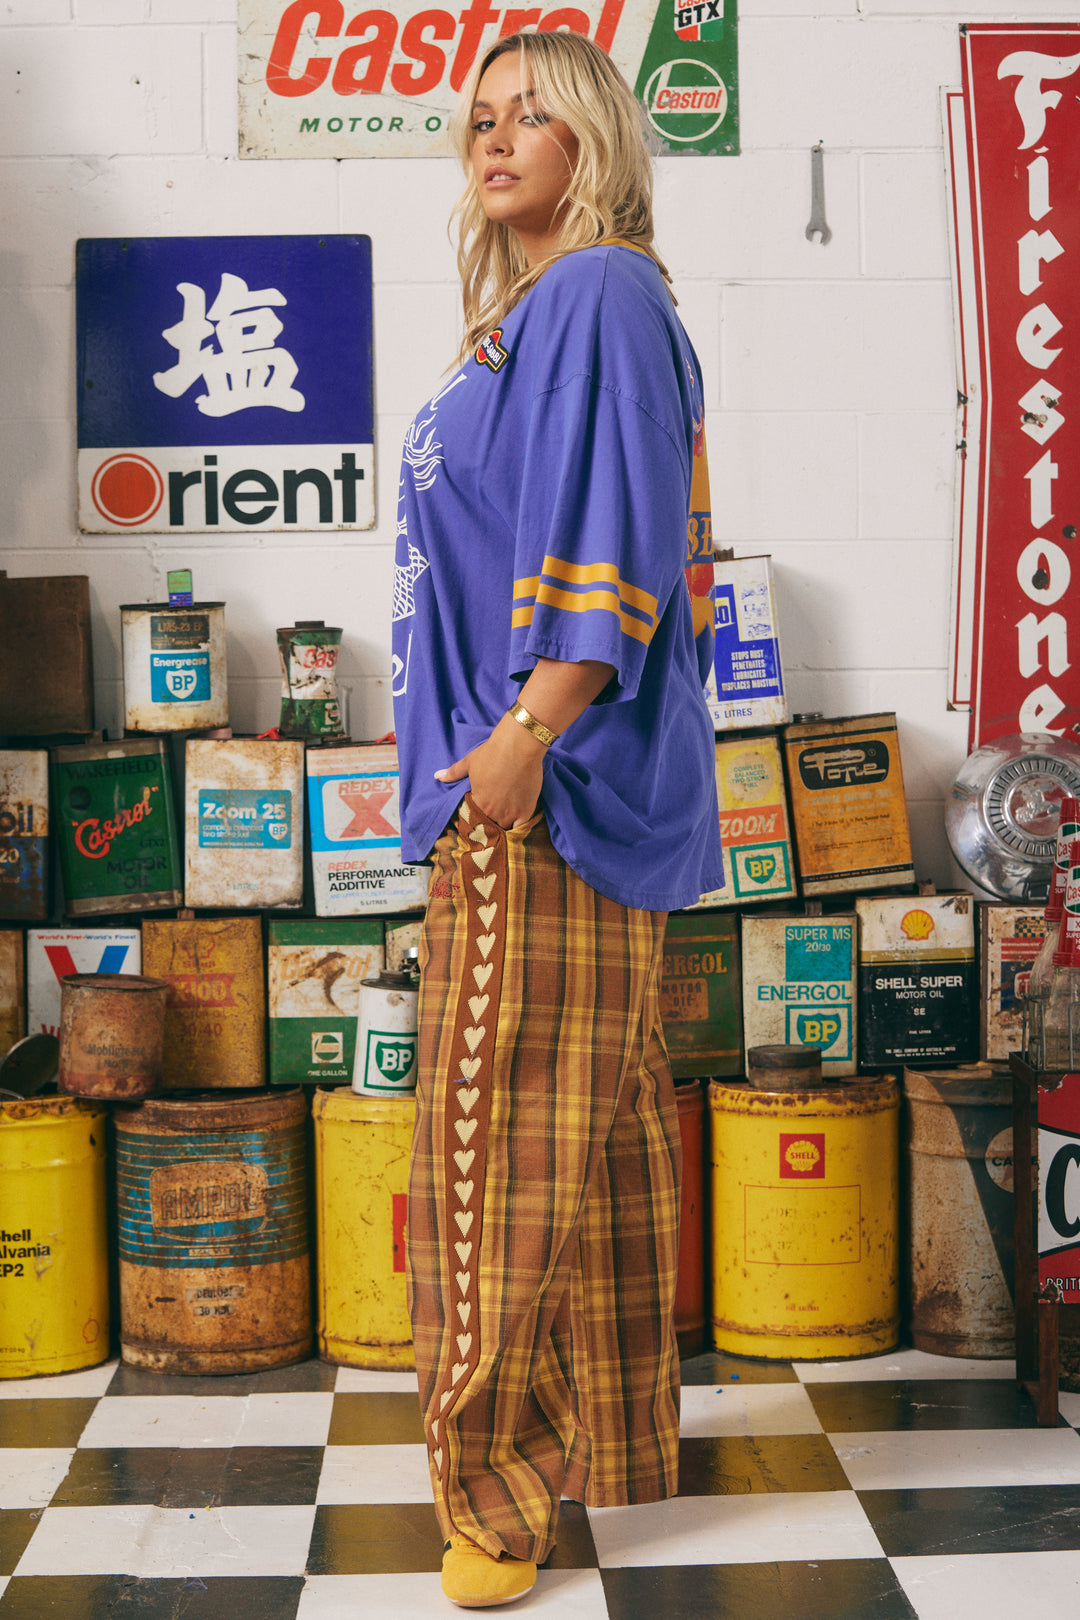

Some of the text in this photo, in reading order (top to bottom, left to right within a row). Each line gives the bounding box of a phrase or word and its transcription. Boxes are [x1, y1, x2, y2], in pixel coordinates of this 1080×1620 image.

[678, 0, 721, 28] GTX
[656, 89, 723, 109] Castrol
[300, 117, 450, 133] MOTOR O
[153, 272, 306, 417] 塩
[996, 50, 1080, 738] Firestone
[153, 657, 208, 669] Energrease
[172, 675, 194, 691] BP
[714, 708, 752, 719] 5 LITRES
[66, 759, 157, 780] WAKEFIELD
[734, 764, 764, 773] COMPLETE
[735, 770, 765, 778] BALANCED
[338, 780, 395, 795] REDEX
[203, 803, 286, 819] Zoom 25
[272, 826, 286, 835] BP
[719, 813, 778, 839] ZOOM
[107, 856, 168, 874] MOTOR
[328, 860, 368, 871] REDEX
[750, 859, 774, 878] BP
[328, 867, 416, 881] PERFORMANCE
[329, 879, 385, 891] ADDITIVE
[787, 927, 851, 941] SUPER MS
[805, 942, 831, 952] 20/30
[875, 975, 963, 990] SHELL SUPER
[758, 984, 852, 1001] ENERGOL
[895, 990, 944, 999] MOTOR OIL
[913, 1007, 926, 1016] SE
[803, 1020, 838, 1042] BP
[380, 1048, 412, 1071] BP
[790, 1152, 816, 1160] SHELL
[161, 1180, 258, 1221] AMPOL
[0, 1229, 31, 1242] hell
[0, 1243, 51, 1259] lvania
[0, 1263, 24, 1277] P2
